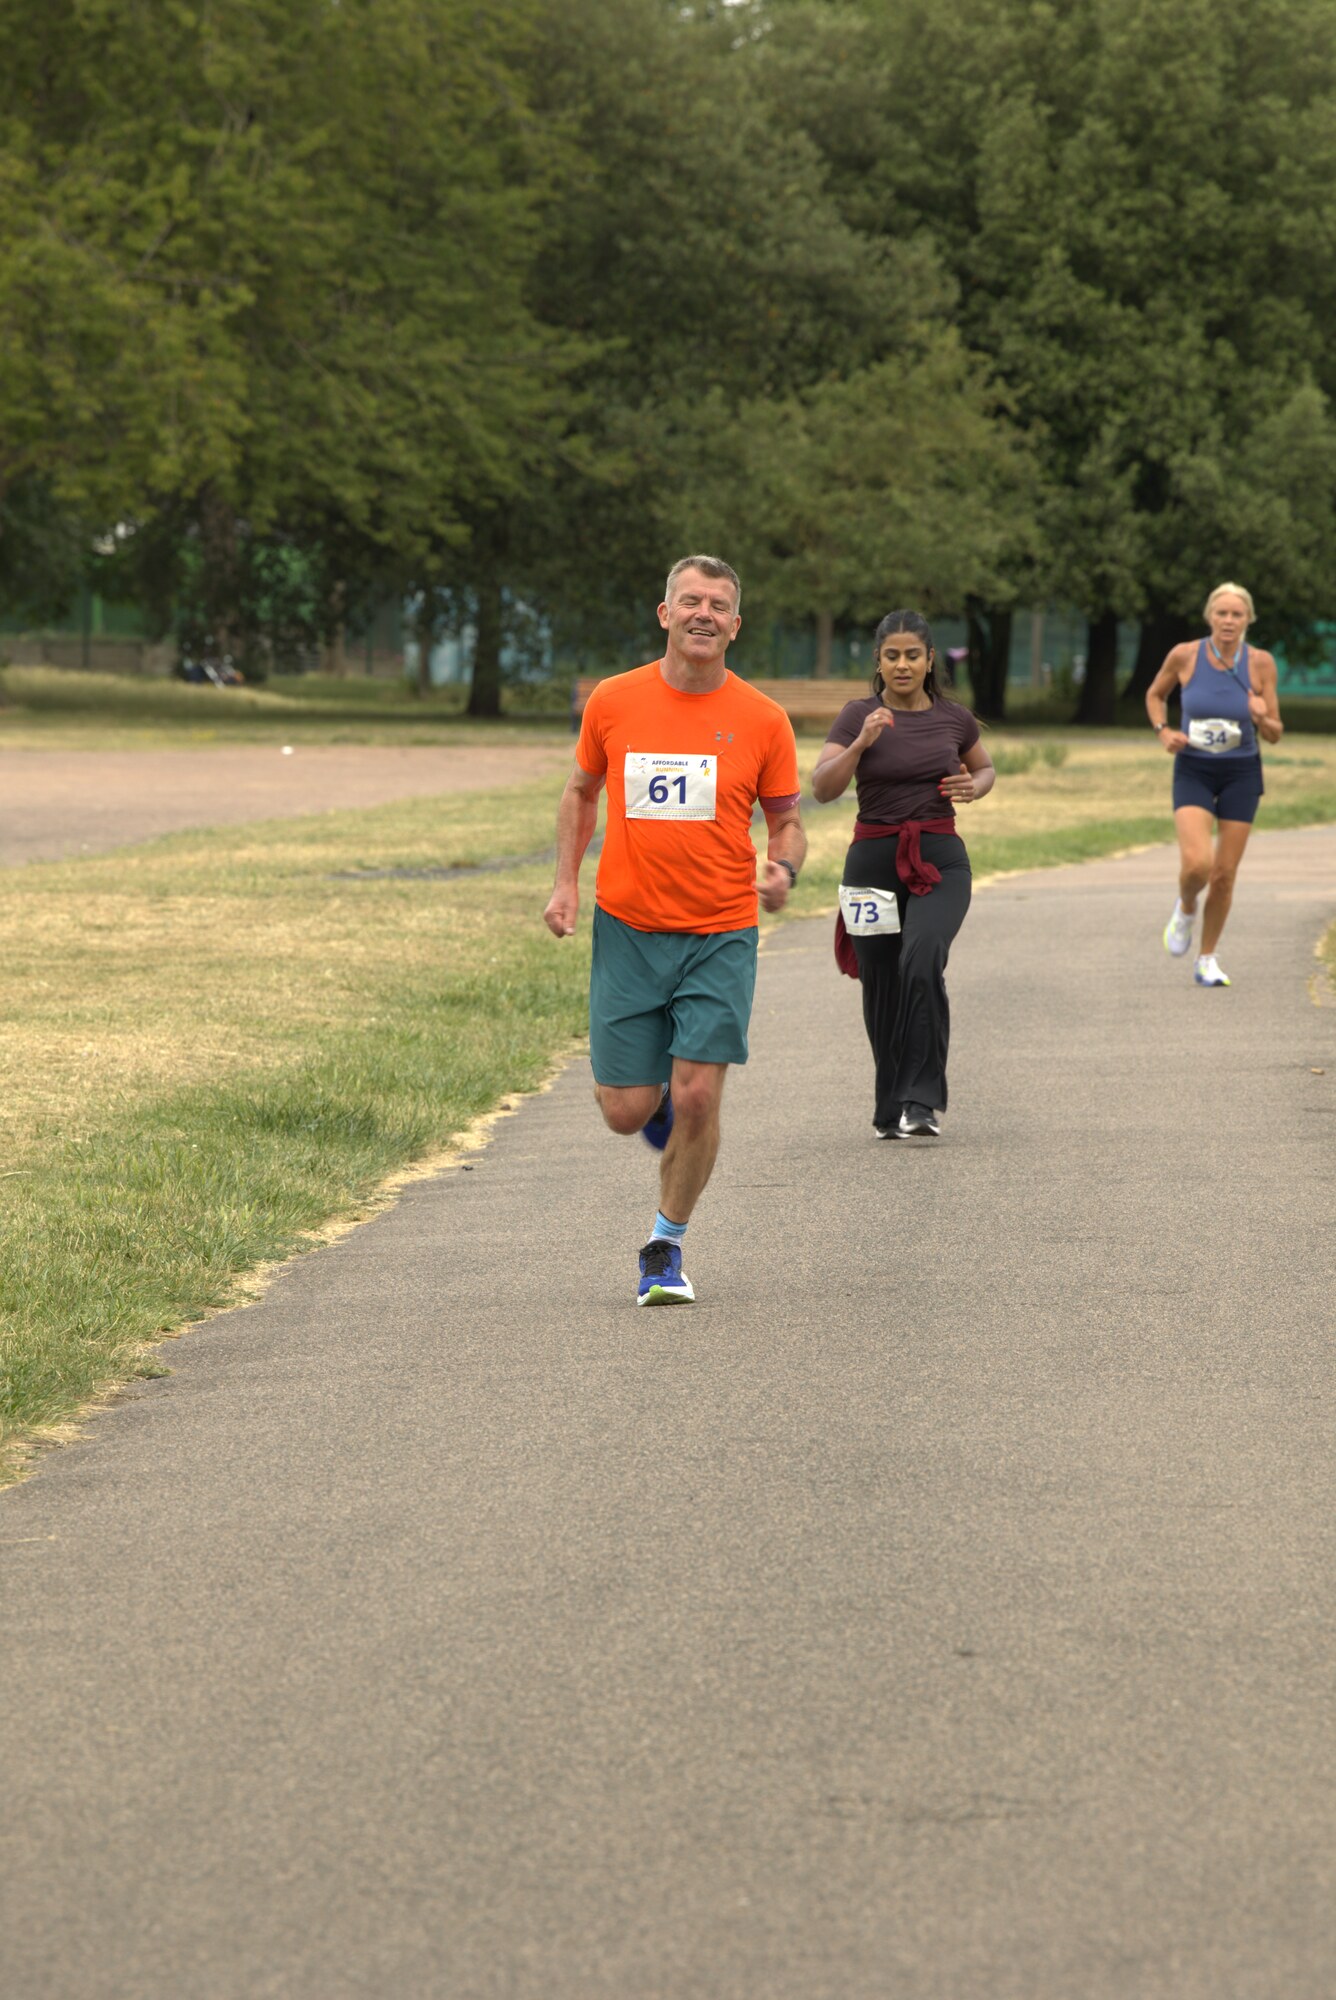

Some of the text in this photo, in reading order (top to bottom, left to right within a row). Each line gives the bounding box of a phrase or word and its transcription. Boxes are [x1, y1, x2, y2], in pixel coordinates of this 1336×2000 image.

[1203, 730, 1227, 746] 34
[700, 759, 708, 768] A
[648, 775, 686, 804] 61
[849, 901, 879, 924] 73
